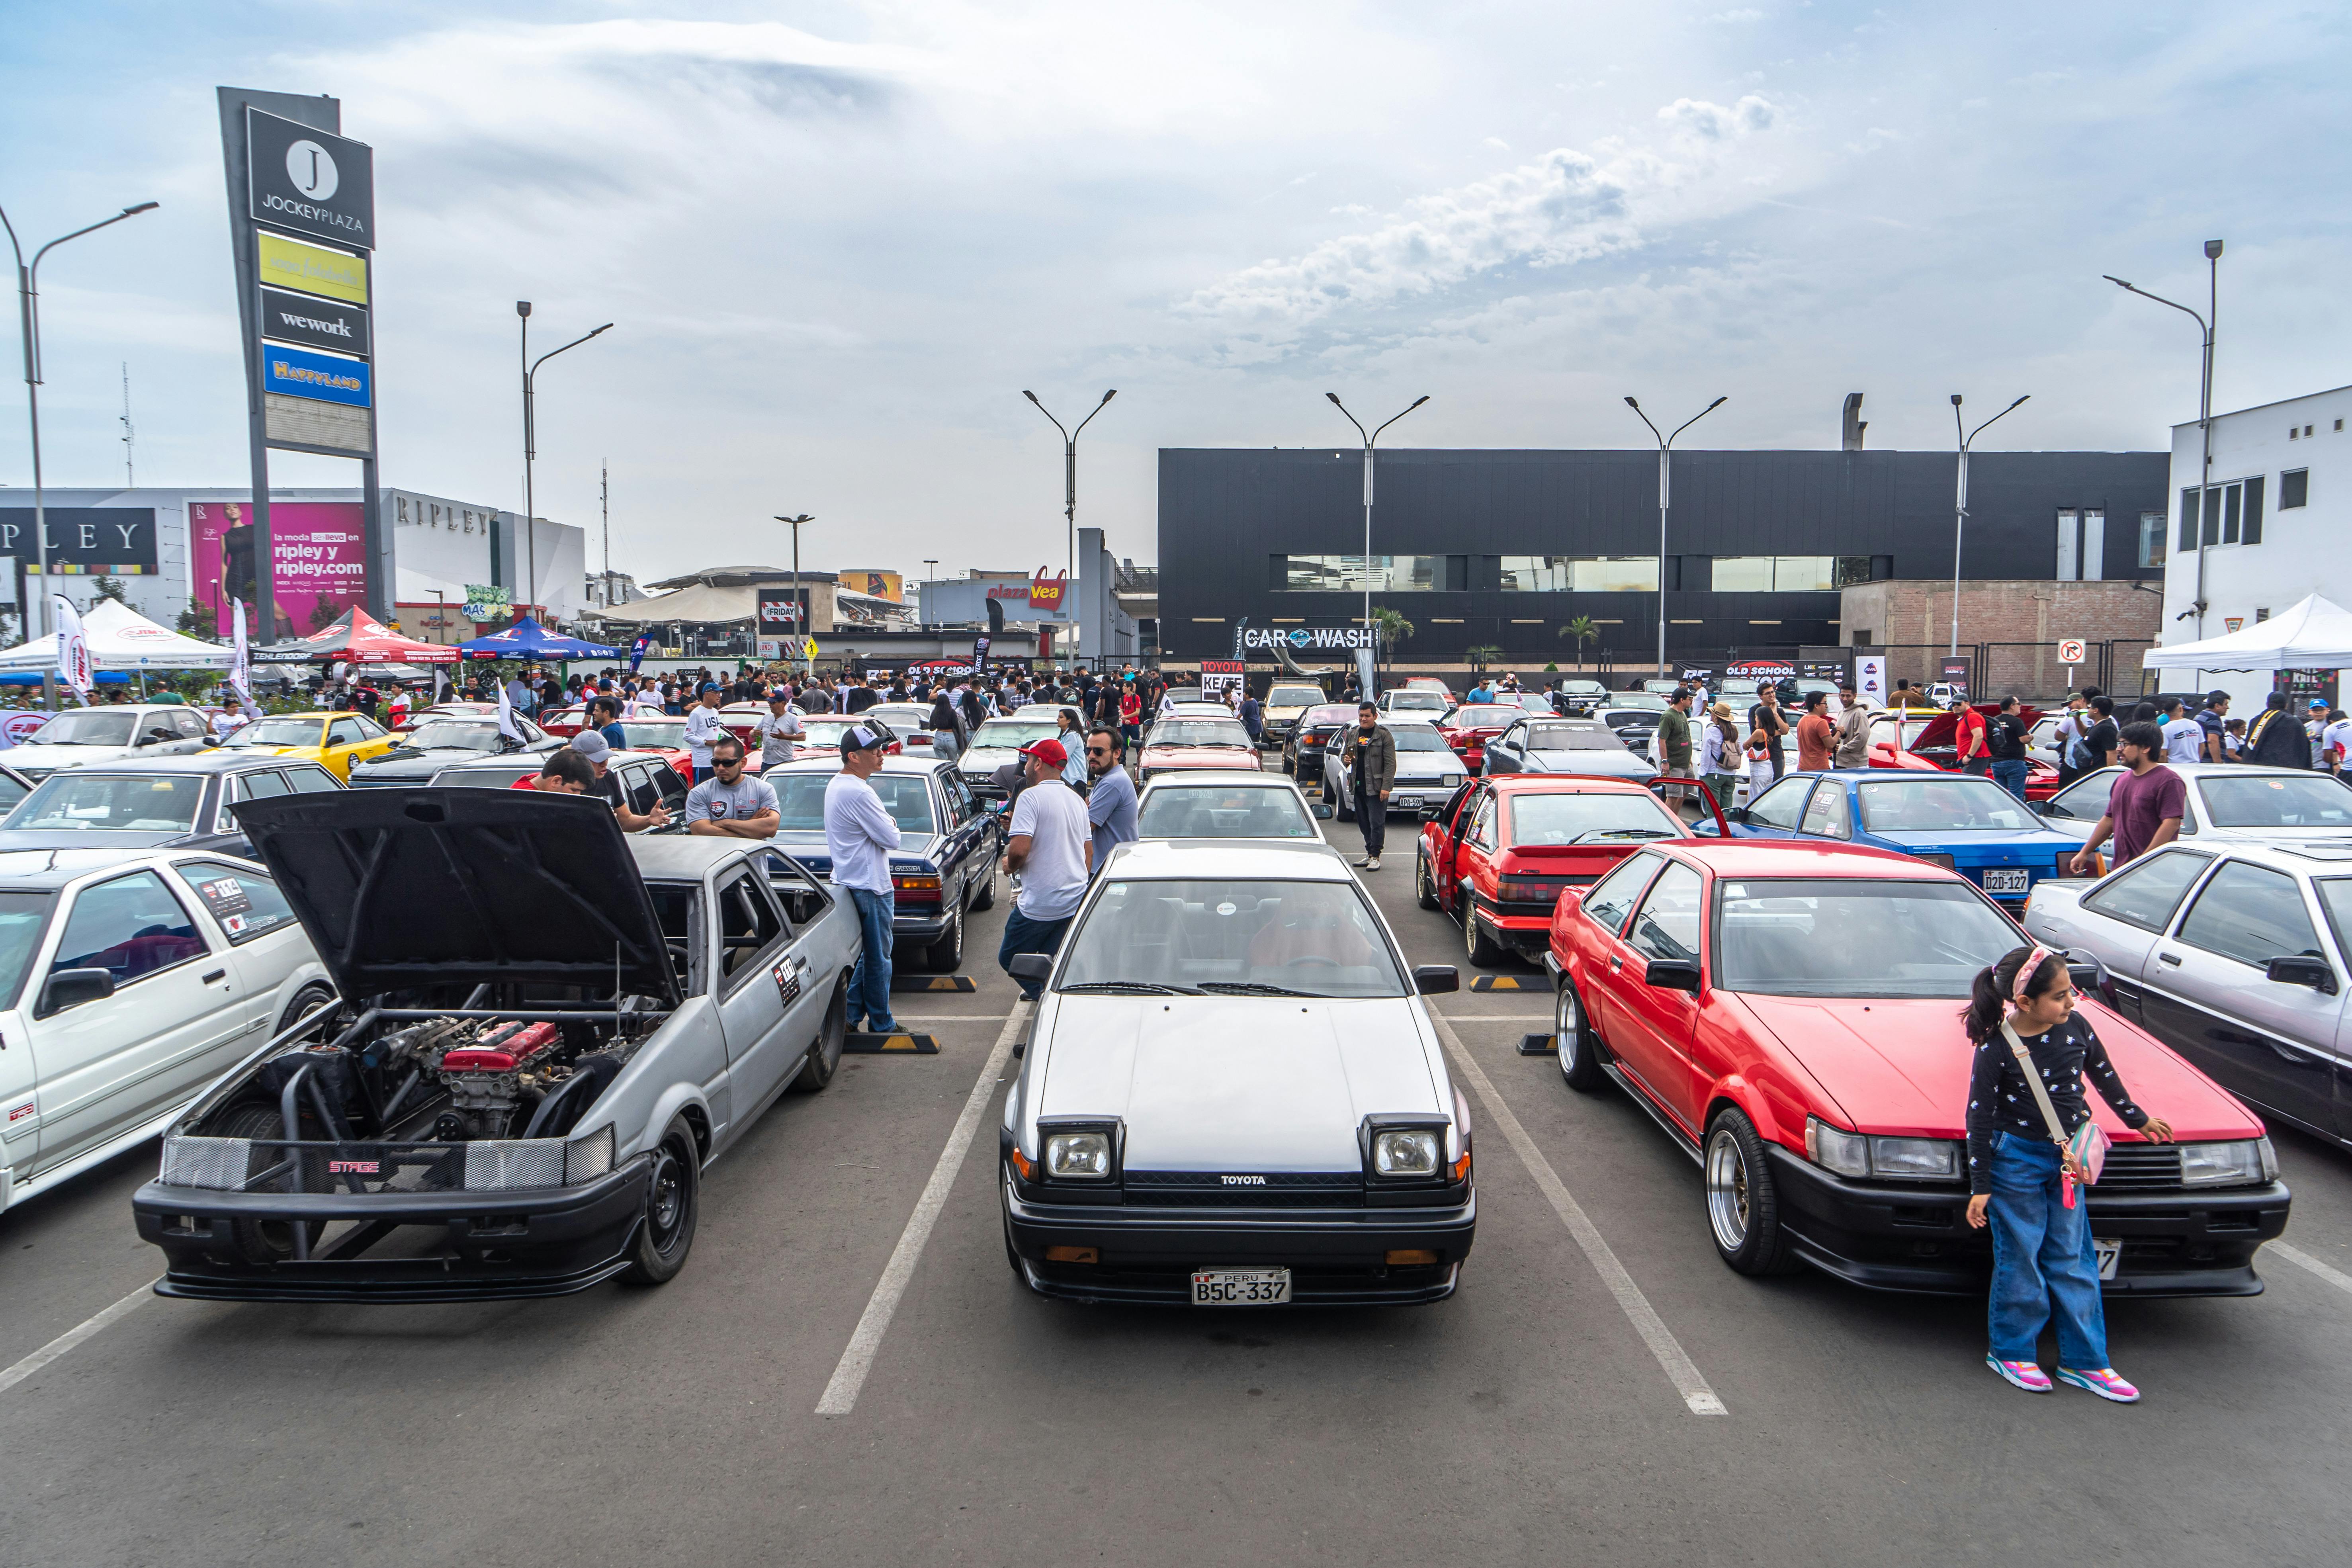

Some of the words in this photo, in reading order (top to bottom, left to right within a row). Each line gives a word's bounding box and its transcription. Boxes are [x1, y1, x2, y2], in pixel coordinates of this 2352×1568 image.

[279, 312, 353, 338] wework
[397, 496, 489, 535] RIPLEY
[275, 544, 323, 560] ripley
[327, 547, 338, 560] y
[276, 560, 364, 577] ripley.com
[987, 584, 1028, 599] plaza
[1031, 586, 1059, 599] Vea
[1245, 629, 1286, 647] CAR
[1314, 629, 1373, 648] WASH
[908, 666, 931, 675] OLD
[1202, 662, 1243, 672] TOYOTA
[219, 880, 239, 894] 114
[1985, 876, 2027, 890] D2D-127
[783, 961, 794, 978] 111
[329, 1161, 379, 1173] STAGE
[1221, 1176, 1266, 1185] TOYOTA
[1197, 1281, 1286, 1301] B5C-337
